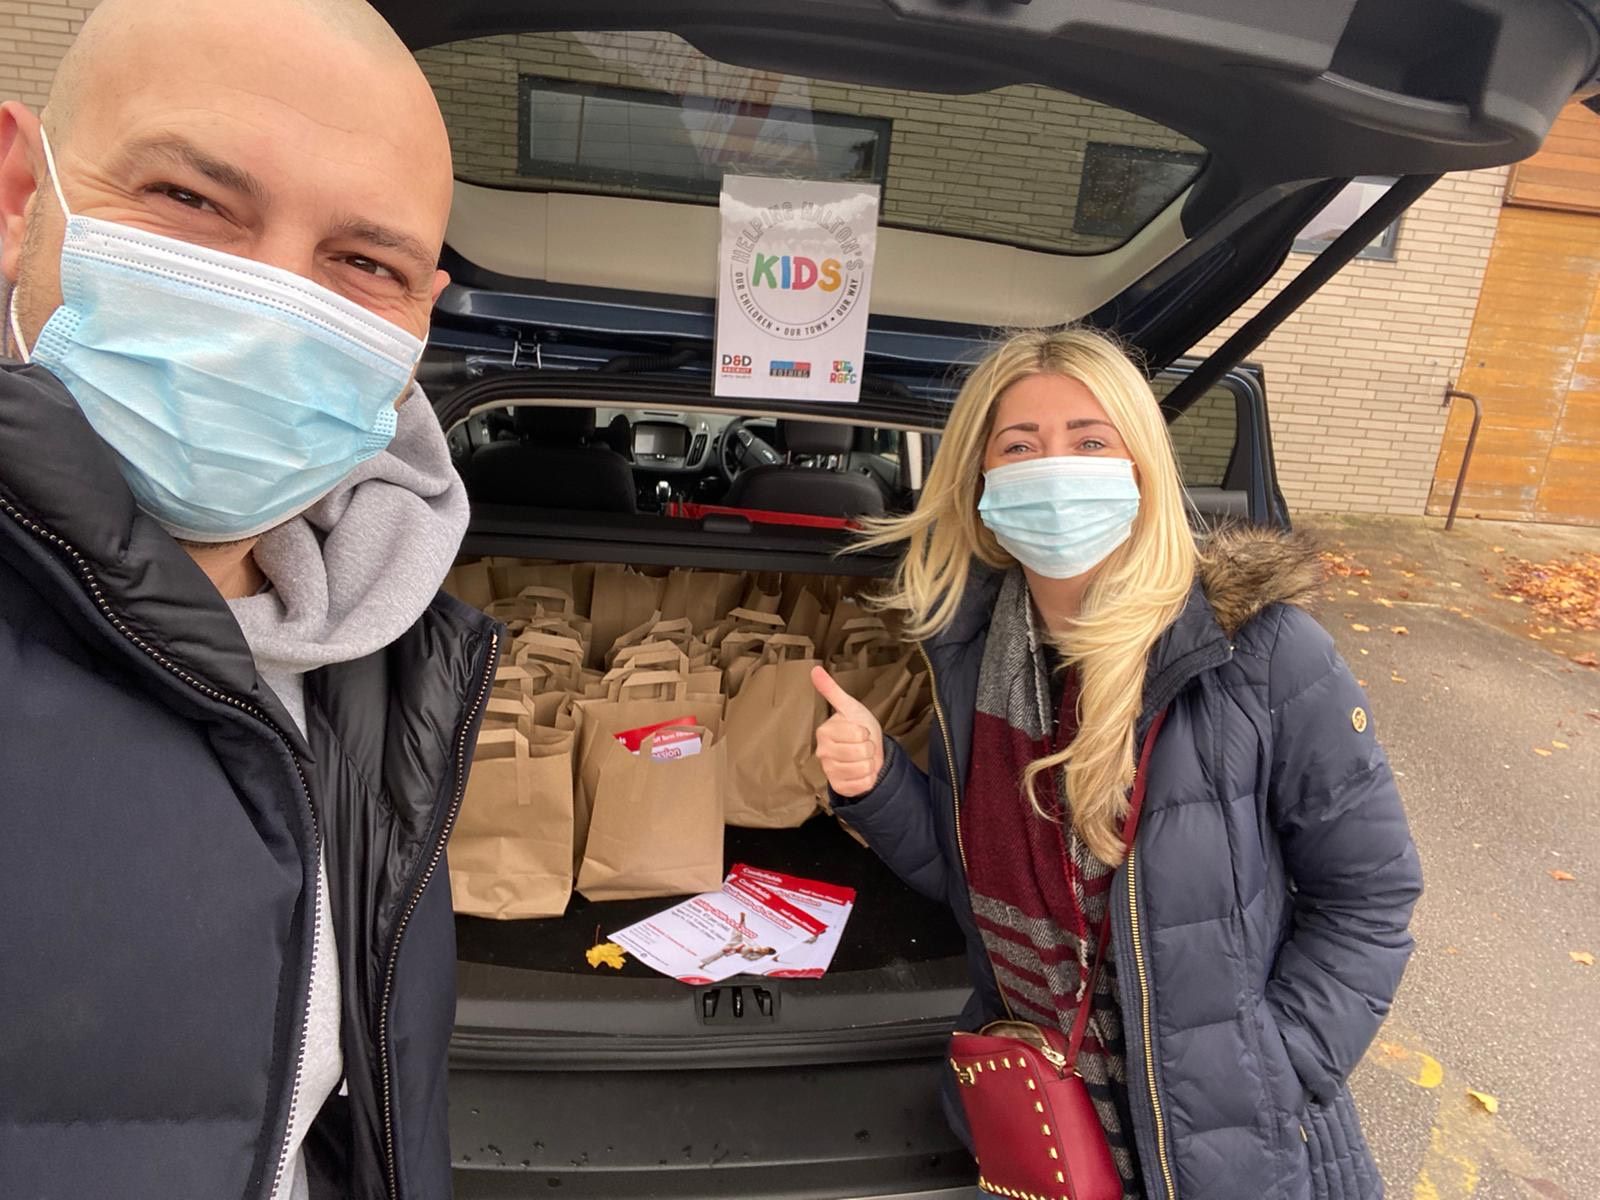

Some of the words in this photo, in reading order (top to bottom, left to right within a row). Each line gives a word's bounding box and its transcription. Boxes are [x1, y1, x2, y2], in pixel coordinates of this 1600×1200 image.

[752, 252, 842, 293] KIDS
[735, 271, 745, 290] OUR
[740, 293, 773, 330] CHILDREN
[784, 327, 802, 337] OUR
[805, 320, 829, 336] TOWN
[836, 299, 852, 317] OUR
[847, 278, 859, 298] WAY
[722, 354, 752, 367] D&D
